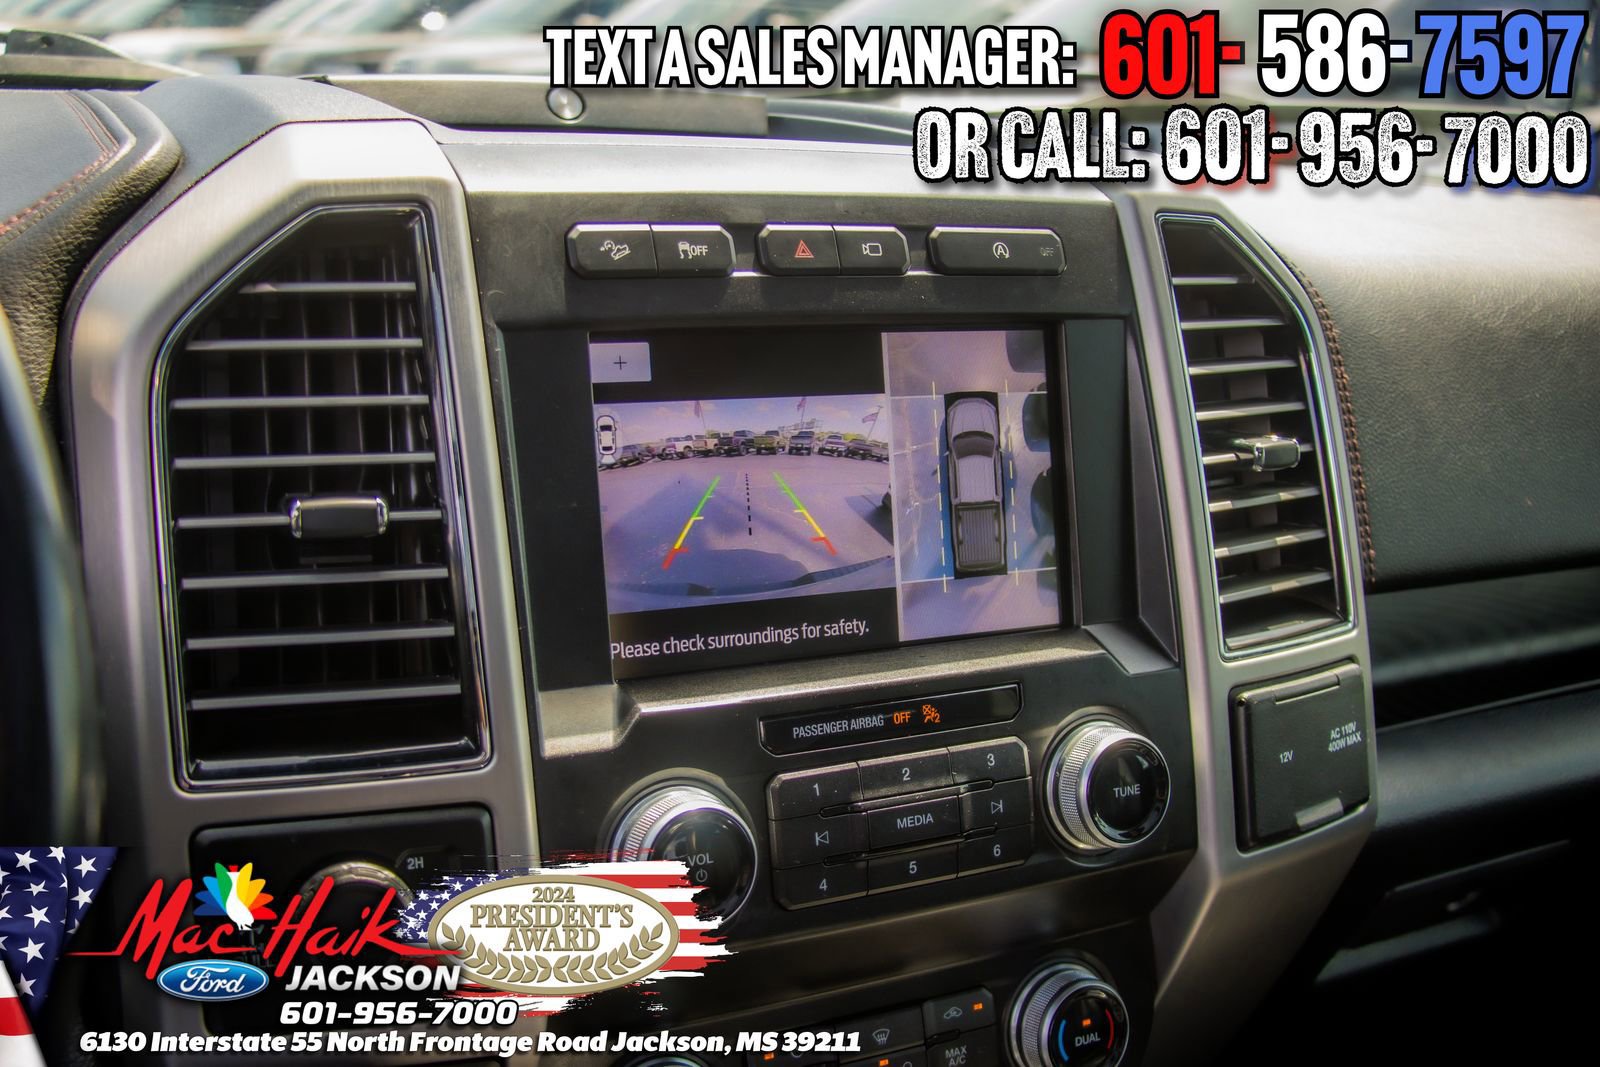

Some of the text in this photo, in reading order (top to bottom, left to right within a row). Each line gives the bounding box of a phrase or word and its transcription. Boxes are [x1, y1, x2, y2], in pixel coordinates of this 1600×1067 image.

[690, 245, 709, 257] OFF
[610, 618, 870, 660] Please check surroundings for safety.
[792, 710, 912, 739] PASSENGER AIRBAG OFF
[1330, 727, 1341, 740] AC
[1346, 731, 1362, 746] MAX
[987, 753, 996, 767] 3
[1279, 750, 1294, 764] 12V
[902, 767, 911, 782] 2
[813, 783, 820, 797] 1
[1113, 784, 1141, 799] TUNE
[896, 812, 934, 830] MEDIA
[993, 844, 1001, 858] 6
[407, 856, 425, 870] 2H
[687, 853, 714, 866] VOL
[909, 860, 917, 874] 5
[819, 877, 828, 893] 4
[1075, 1032, 1101, 1047] DUAL
[945, 1045, 967, 1059] MAX
[949, 1055, 966, 1067] A/C
